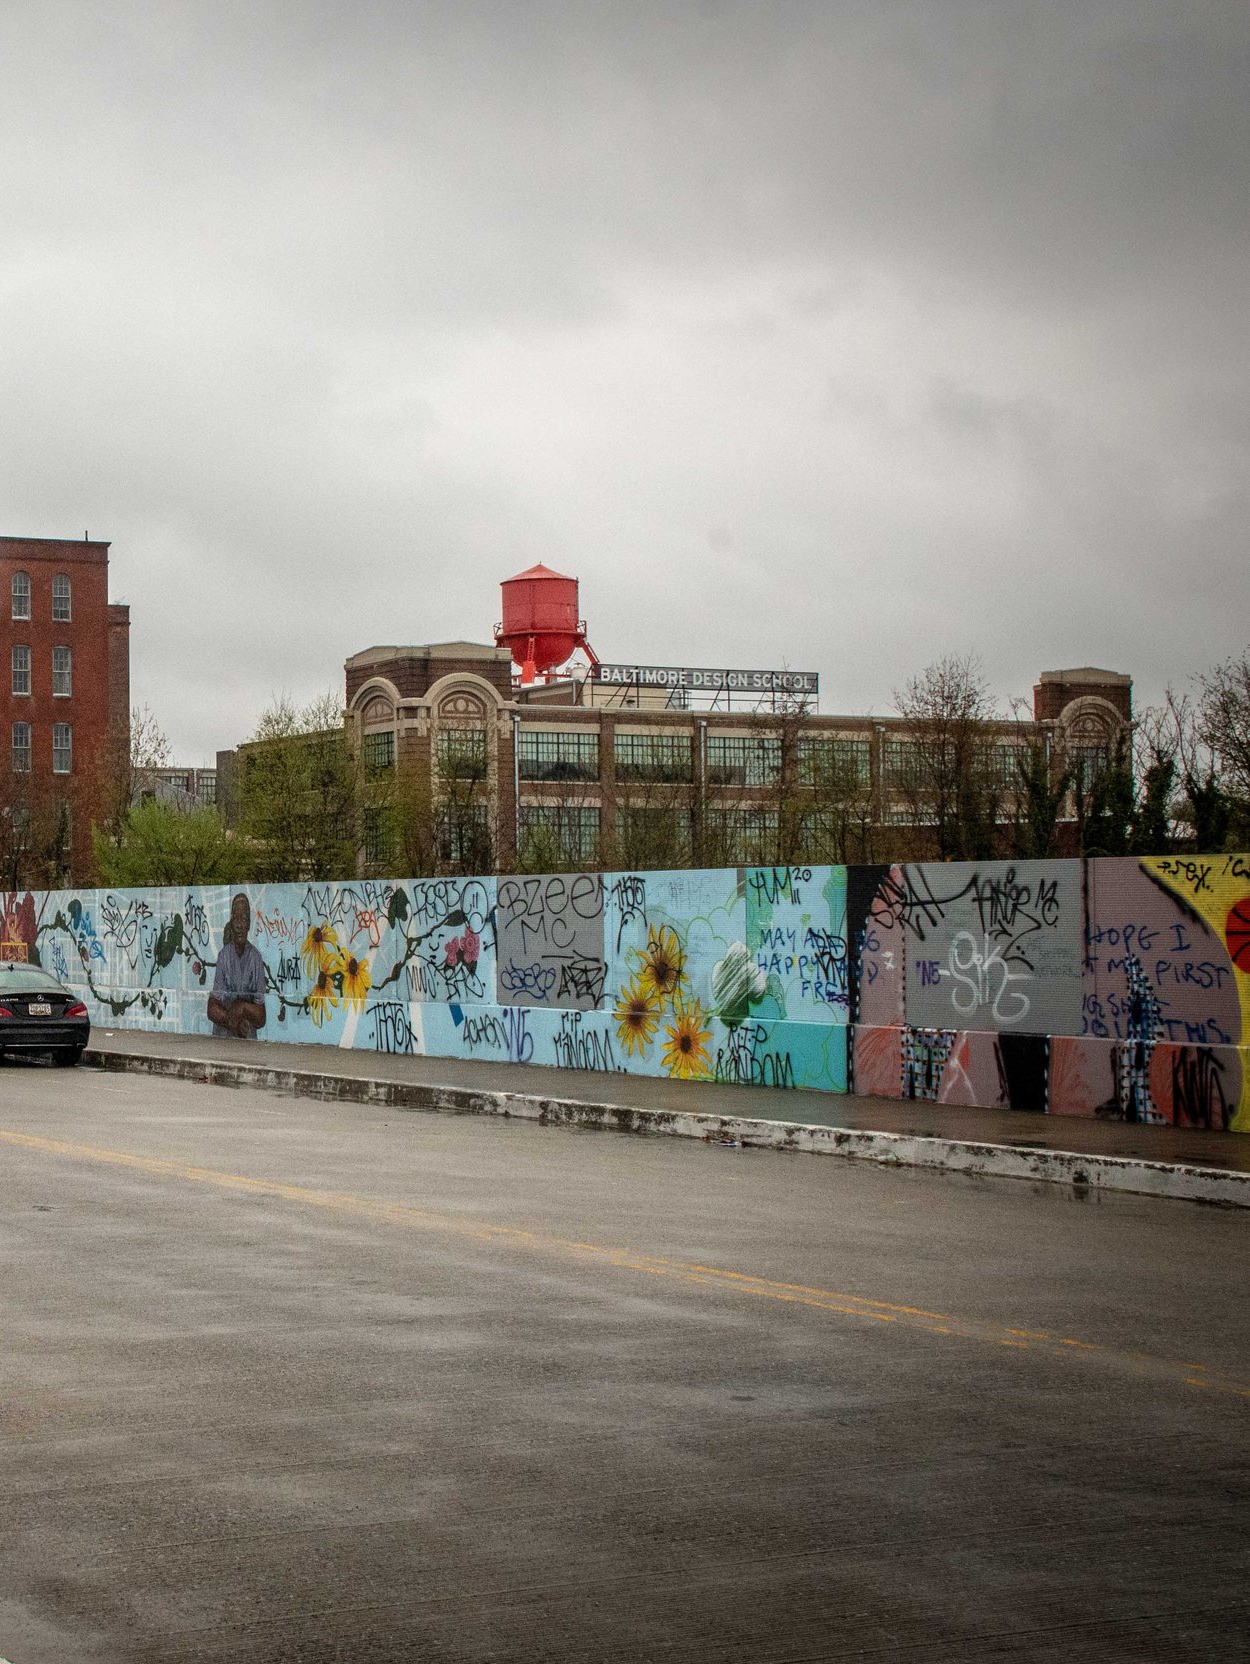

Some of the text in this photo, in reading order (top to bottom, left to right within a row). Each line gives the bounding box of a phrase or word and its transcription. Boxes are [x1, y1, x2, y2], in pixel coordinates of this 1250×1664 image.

[600, 667, 812, 689] BALTIMORE DESIGN SCHOOL
